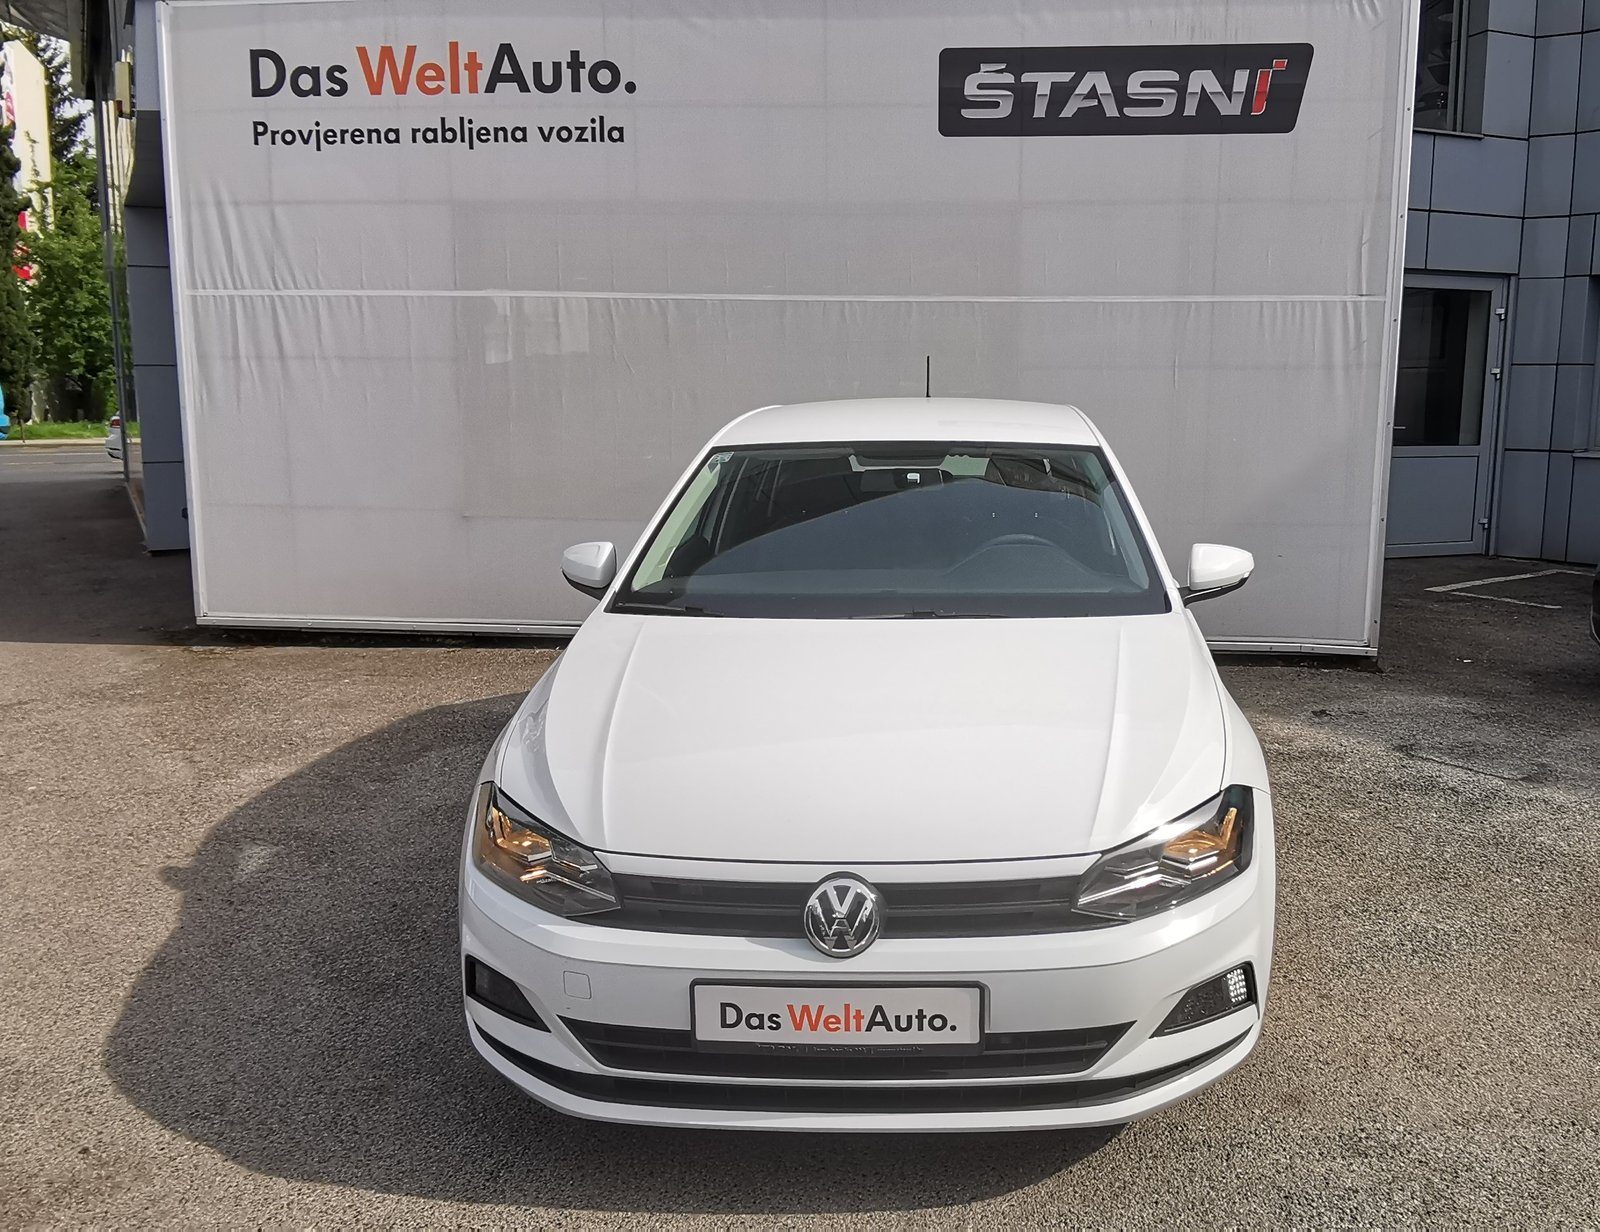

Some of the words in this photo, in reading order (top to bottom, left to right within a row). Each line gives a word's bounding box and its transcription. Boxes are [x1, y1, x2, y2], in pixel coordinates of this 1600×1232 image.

[248, 48, 349, 98] Das
[355, 41, 637, 97] WeltAuto.
[252, 120, 401, 152] Provjerena
[410, 116, 528, 150] rabljena
[537, 115, 625, 144] vozila
[719, 1001, 782, 1031] Das
[786, 1003, 957, 1033] WeltAuto.
